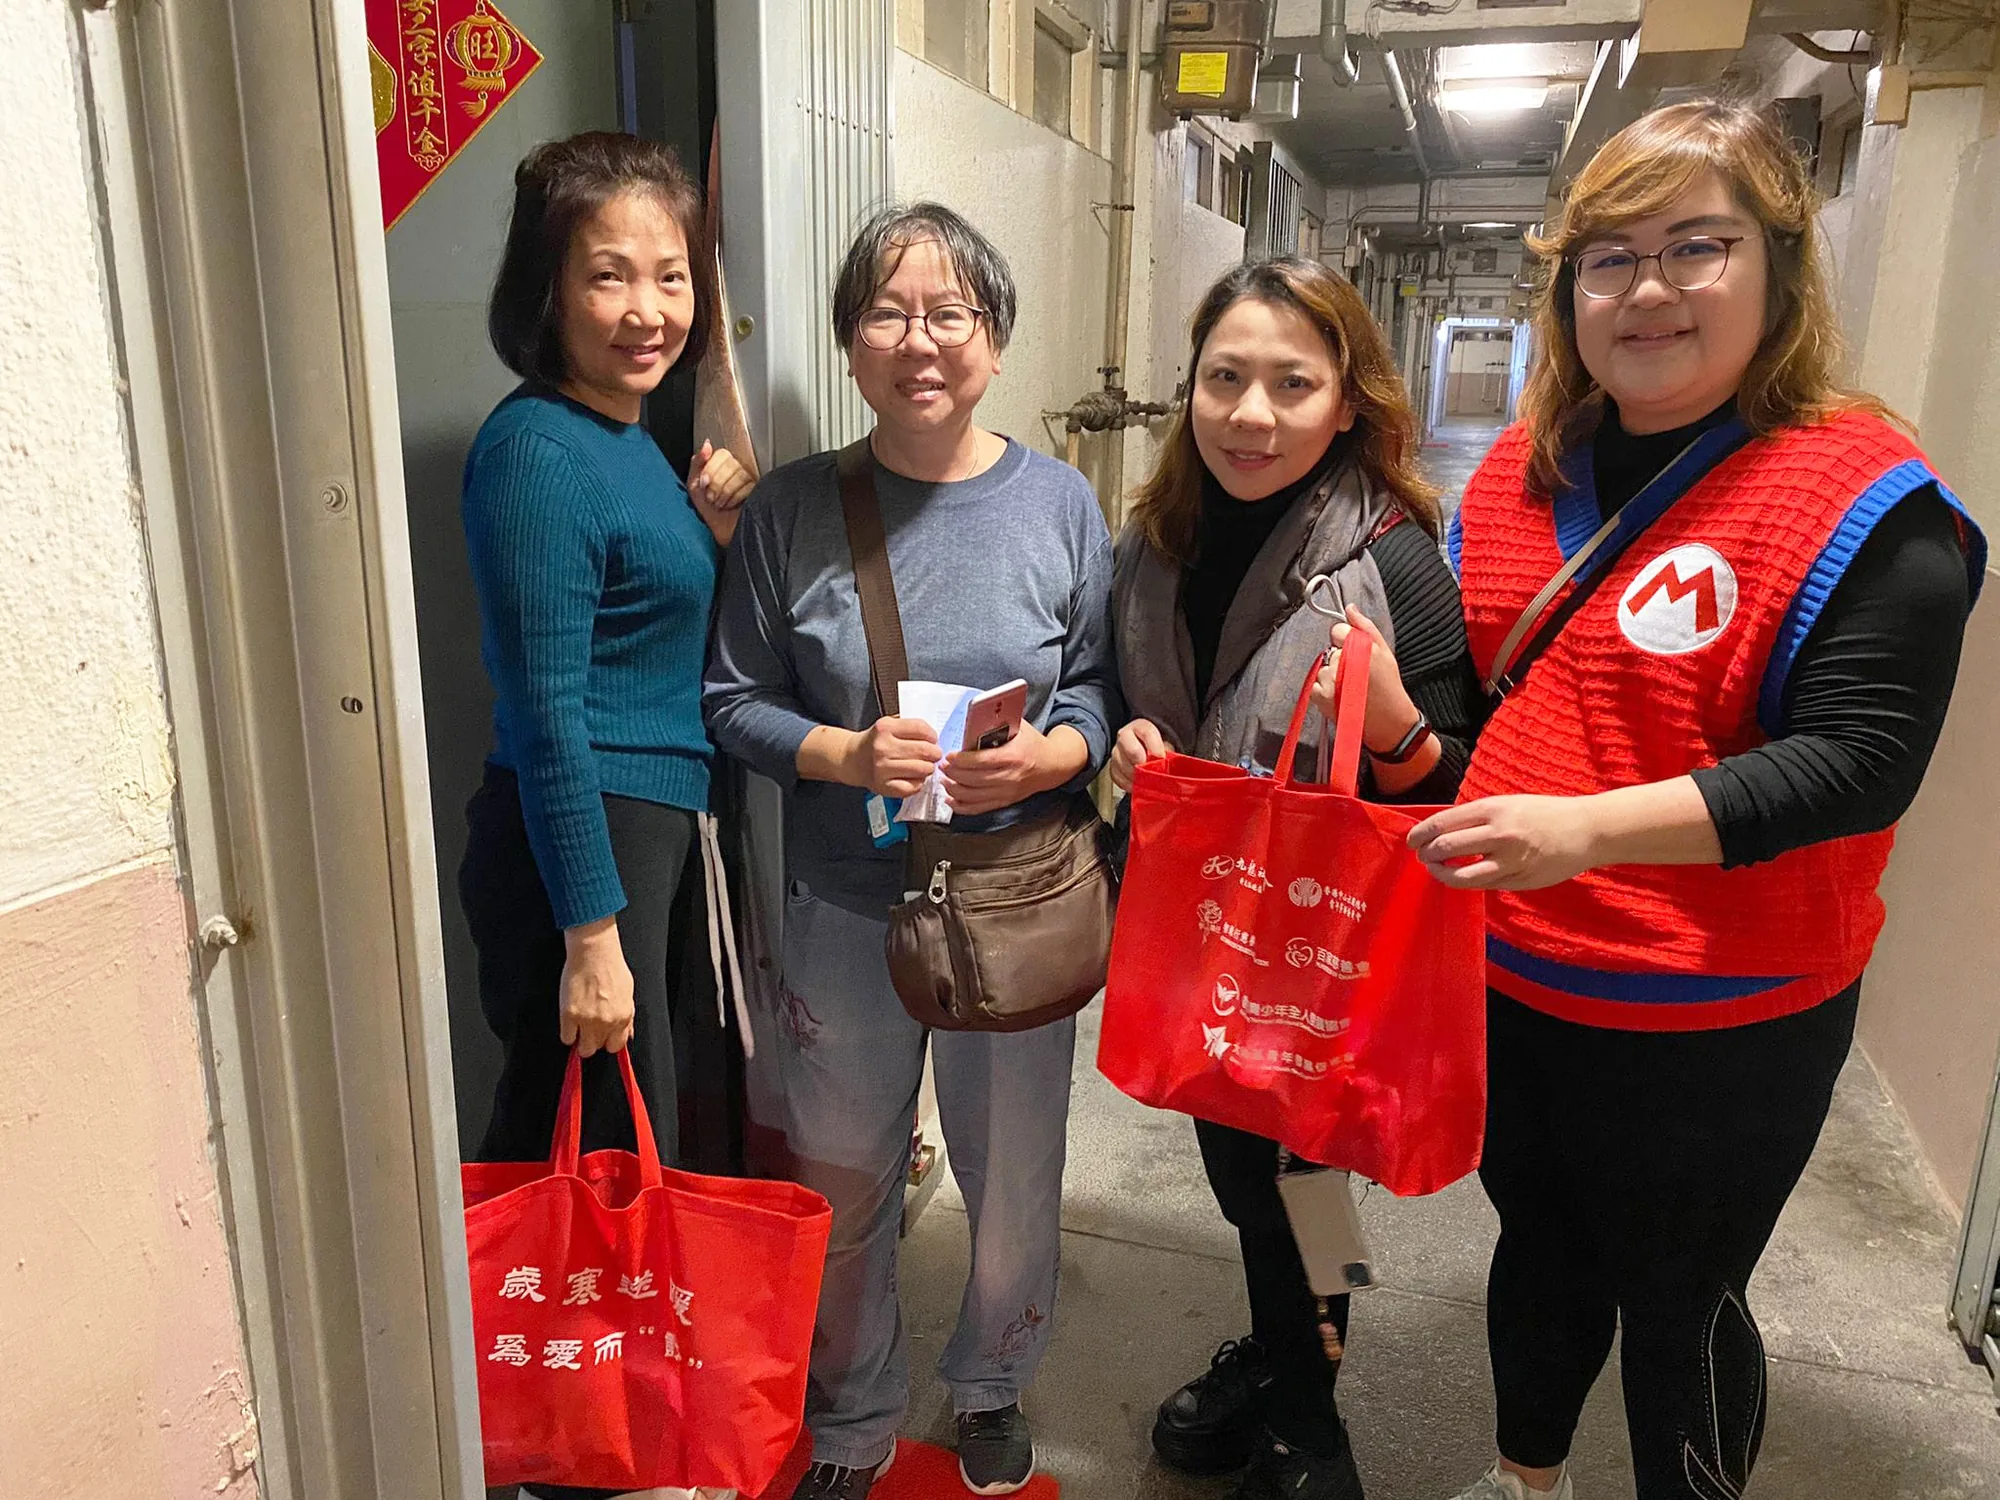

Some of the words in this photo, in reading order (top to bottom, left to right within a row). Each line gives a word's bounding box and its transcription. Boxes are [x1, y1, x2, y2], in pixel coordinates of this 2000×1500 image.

[470, 30, 499, 61] 旺
[1626, 560, 1720, 634] M
[498, 1265, 695, 1326] 歲寒送暖
